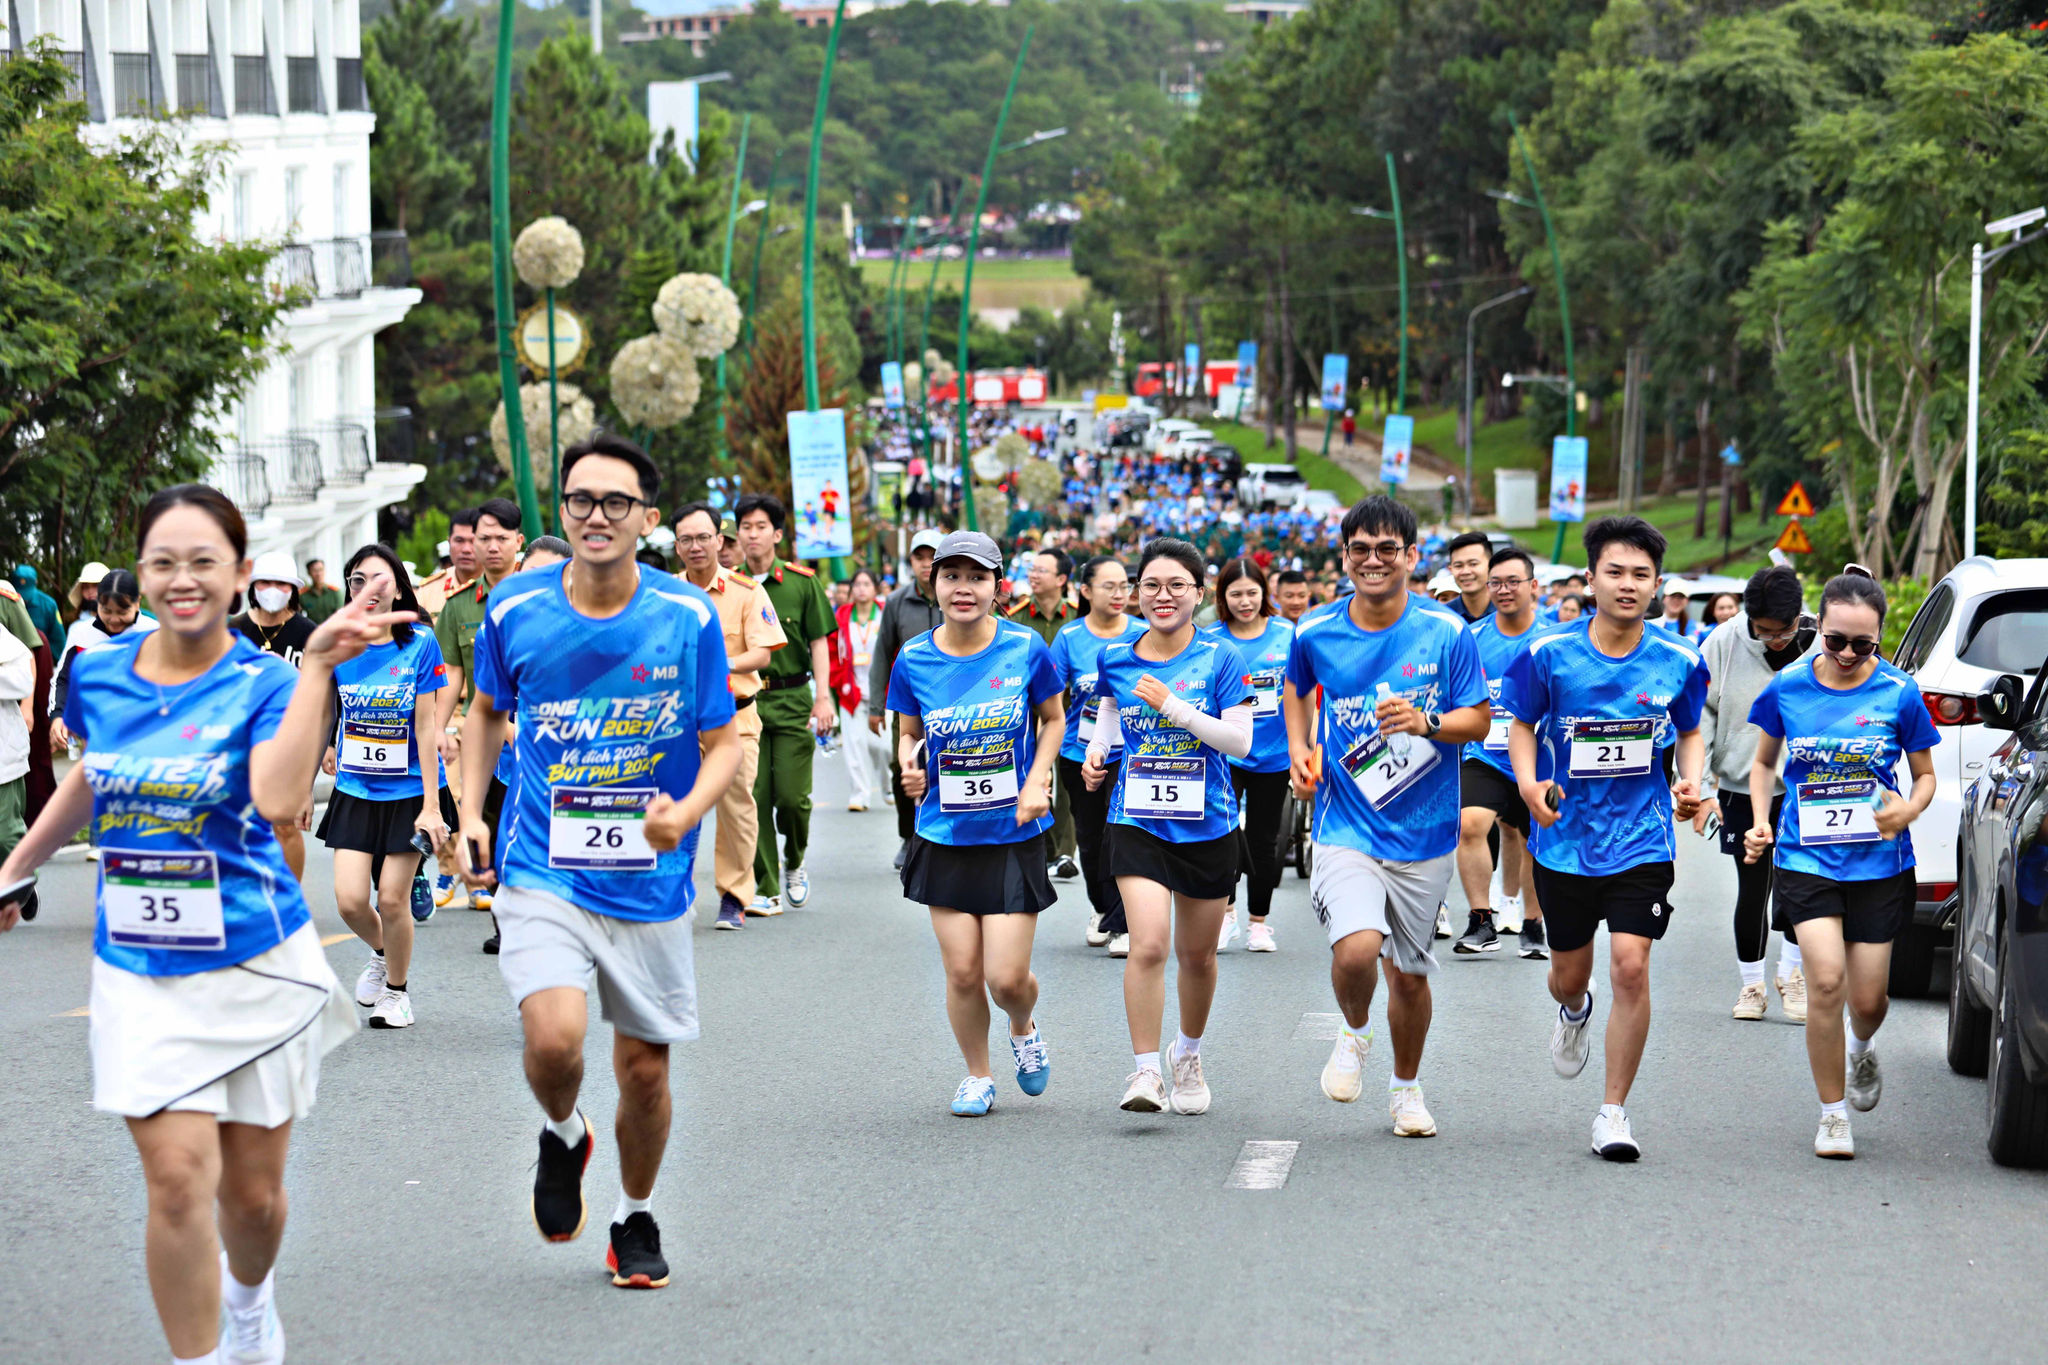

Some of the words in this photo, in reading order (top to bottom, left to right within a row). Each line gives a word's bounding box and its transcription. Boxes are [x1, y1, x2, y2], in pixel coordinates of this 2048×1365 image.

[400, 667, 415, 676] MB
[652, 665, 679, 680] MB
[1418, 663, 1438, 676] MB
[1004, 676, 1022, 688] MB
[1188, 680, 1207, 690] MB
[340, 693, 371, 710] RUN
[371, 698, 401, 707] 2027
[537, 698, 582, 718] ONE
[377, 711, 399, 720] 2026
[928, 706, 956, 720] ONE
[1120, 705, 1142, 717] ONE
[924, 717, 971, 740] RUN
[971, 715, 1010, 731] 2027
[1334, 709, 1379, 733] RUN
[530, 716, 603, 745] RUN
[600, 719, 655, 738] 2027
[980, 732, 1006, 745] 2026
[1792, 737, 1819, 748] ONE
[363, 746, 387, 762] 16
[612, 744, 649, 762] 2026
[1597, 745, 1626, 763] 21
[1790, 747, 1834, 765] RUN
[1834, 752, 1871, 764] 2027
[622, 751, 666, 776] 2027
[137, 781, 200, 800] 2027
[963, 778, 993, 797] 36
[1150, 784, 1179, 803] 15
[1825, 808, 1854, 827] 27
[585, 825, 624, 849] 26
[140, 895, 181, 923] 35
